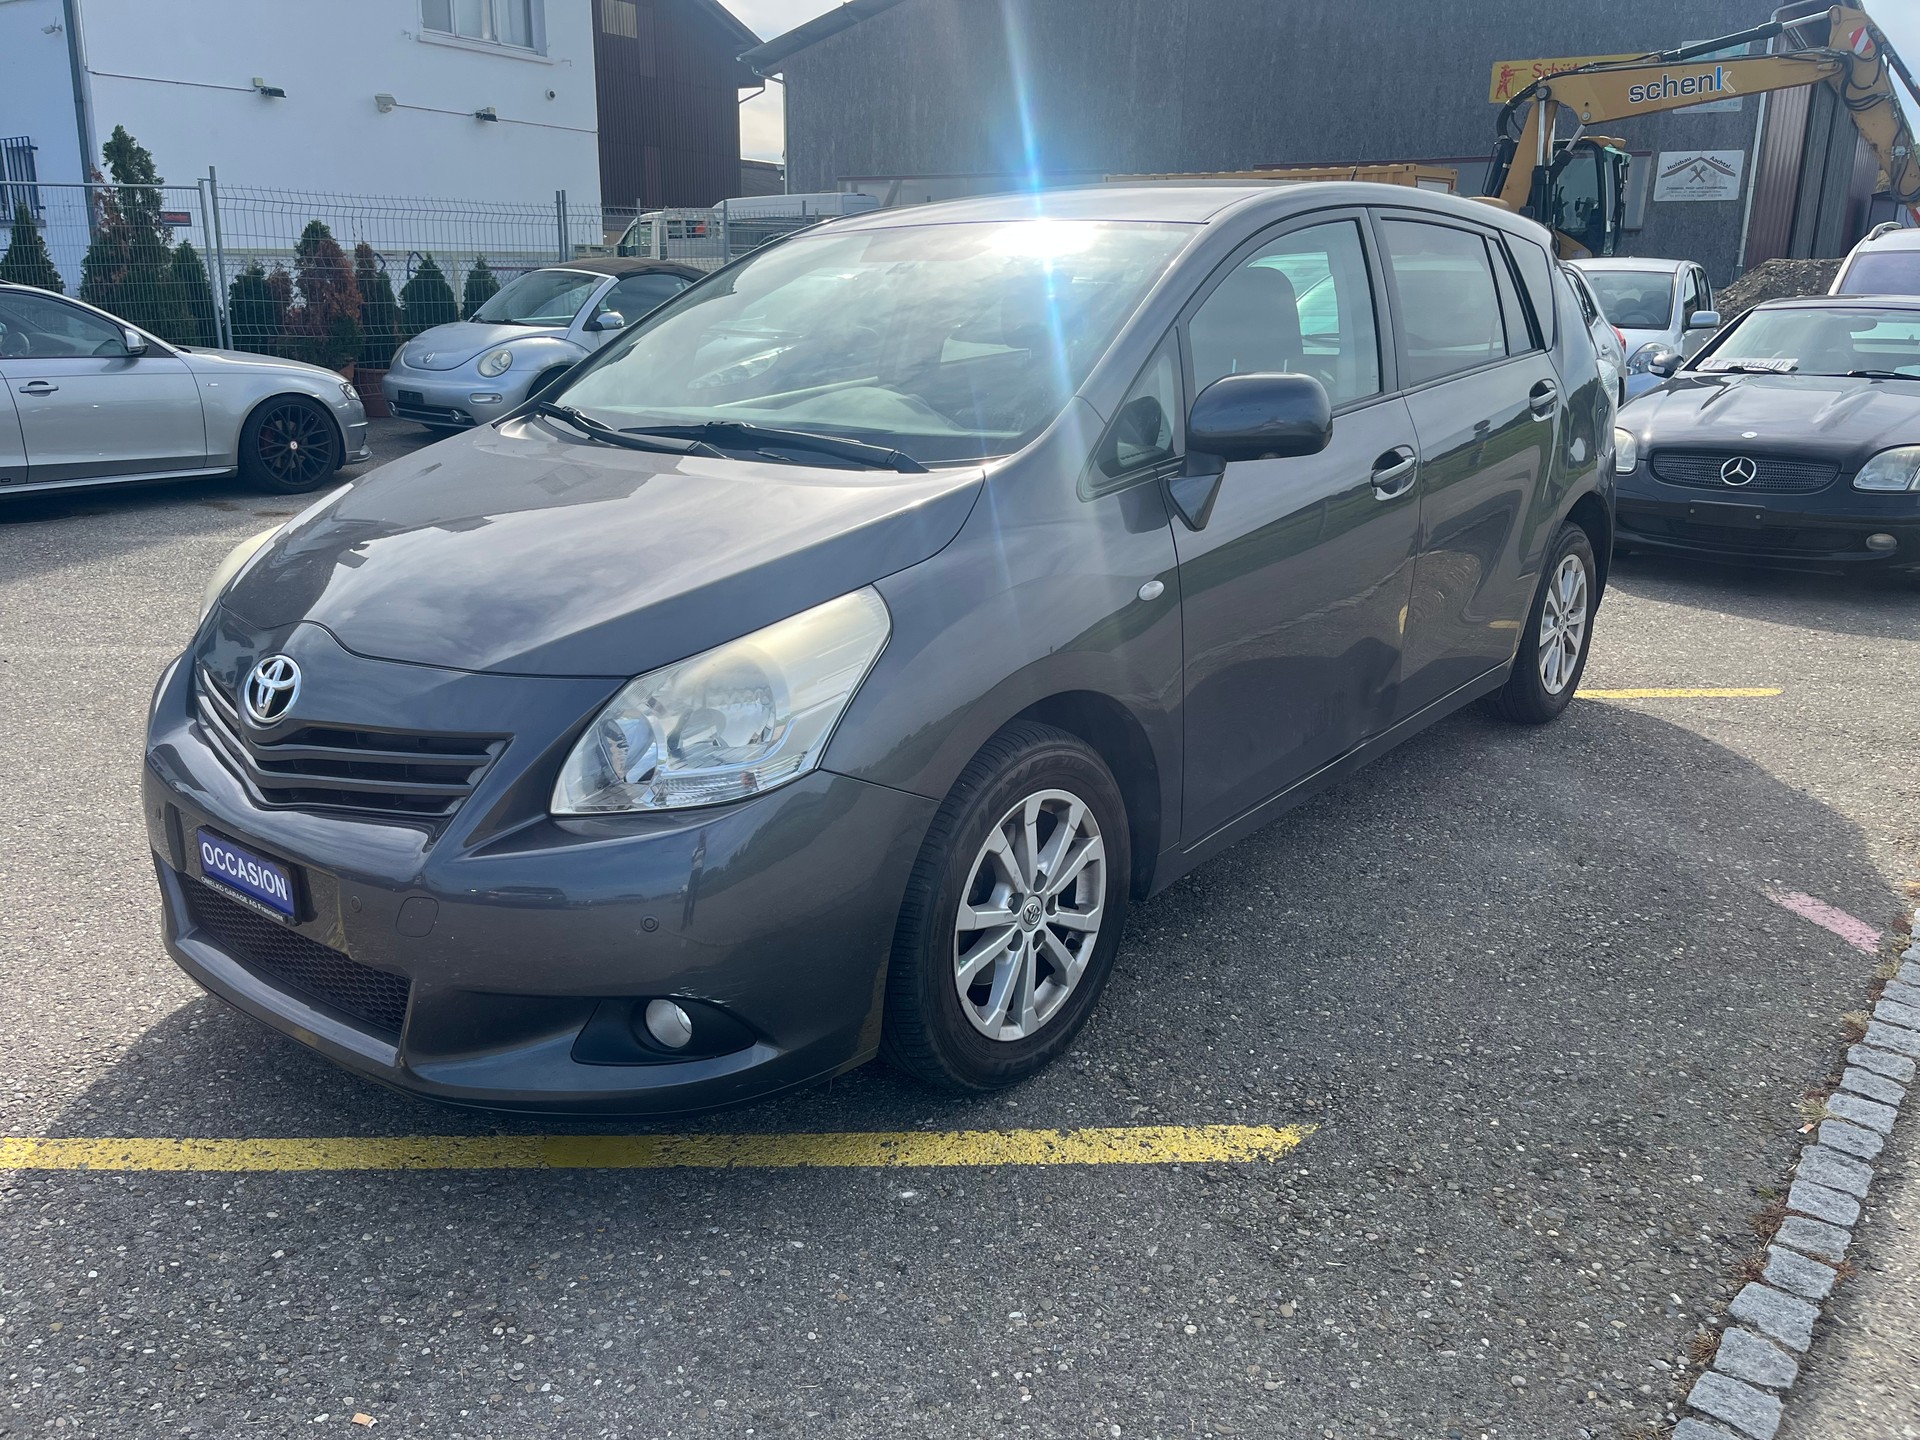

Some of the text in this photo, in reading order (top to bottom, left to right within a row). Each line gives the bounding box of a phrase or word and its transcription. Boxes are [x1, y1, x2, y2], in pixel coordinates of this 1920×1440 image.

[1628, 65, 1737, 104] schenk
[1667, 156, 1732, 170] Holzbau Aachtal
[202, 842, 288, 901] OCCASION
